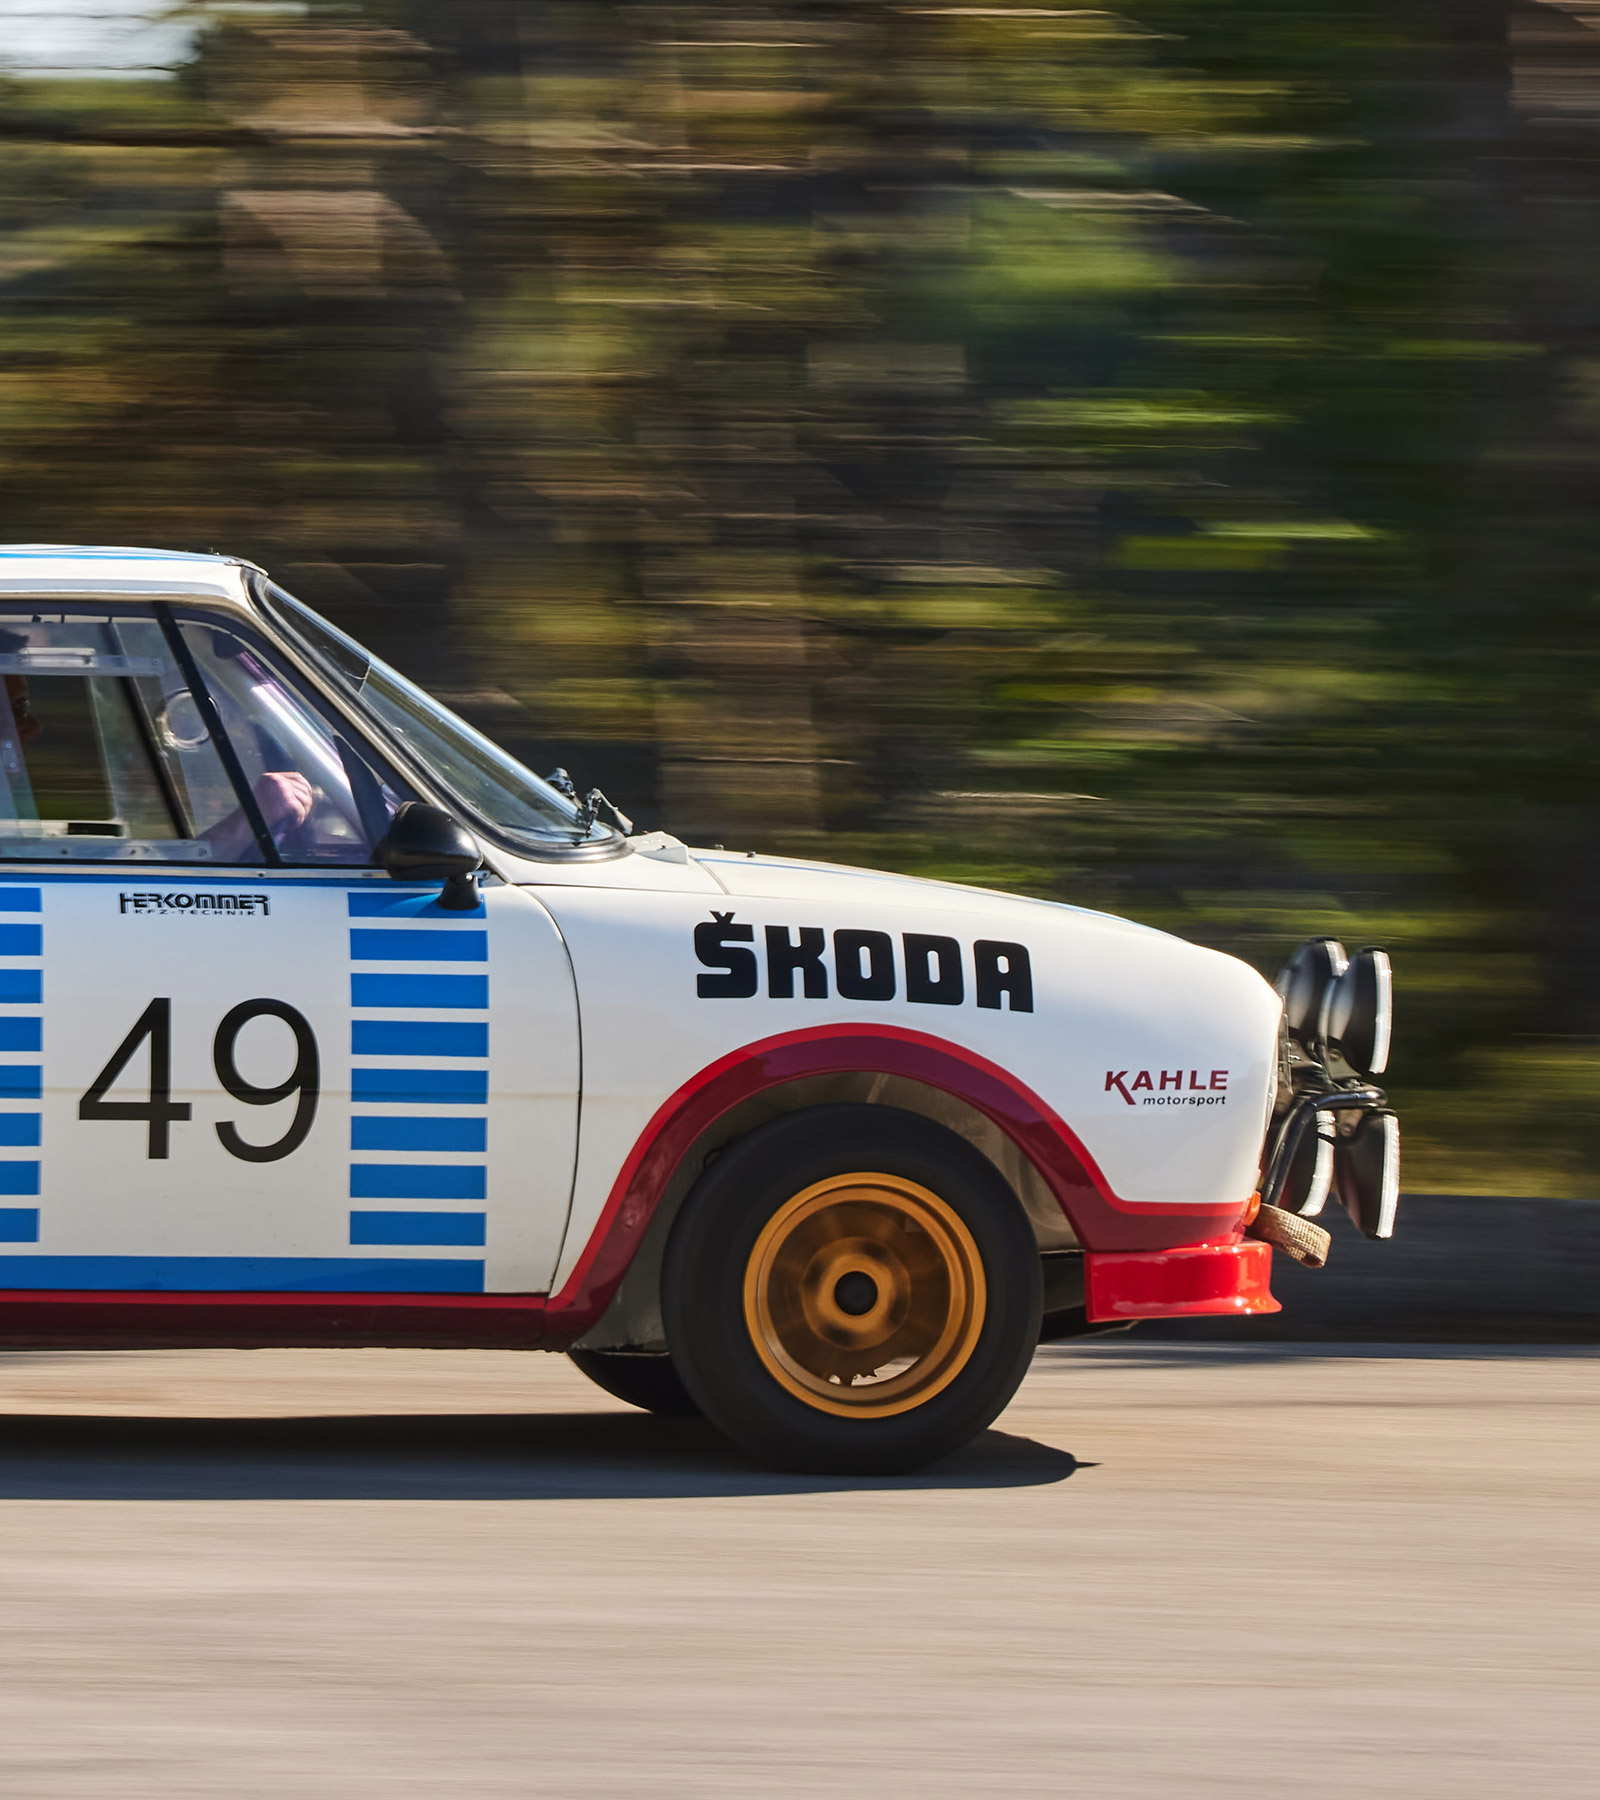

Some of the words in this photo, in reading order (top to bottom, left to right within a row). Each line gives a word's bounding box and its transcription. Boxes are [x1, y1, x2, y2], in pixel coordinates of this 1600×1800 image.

[119, 893, 271, 915] HERKOMMER
[694, 911, 1034, 1013] ŠKODA
[79, 997, 320, 1162] 49
[1104, 1070, 1229, 1105] KAHLE
[1143, 1096, 1226, 1107] motorsport
